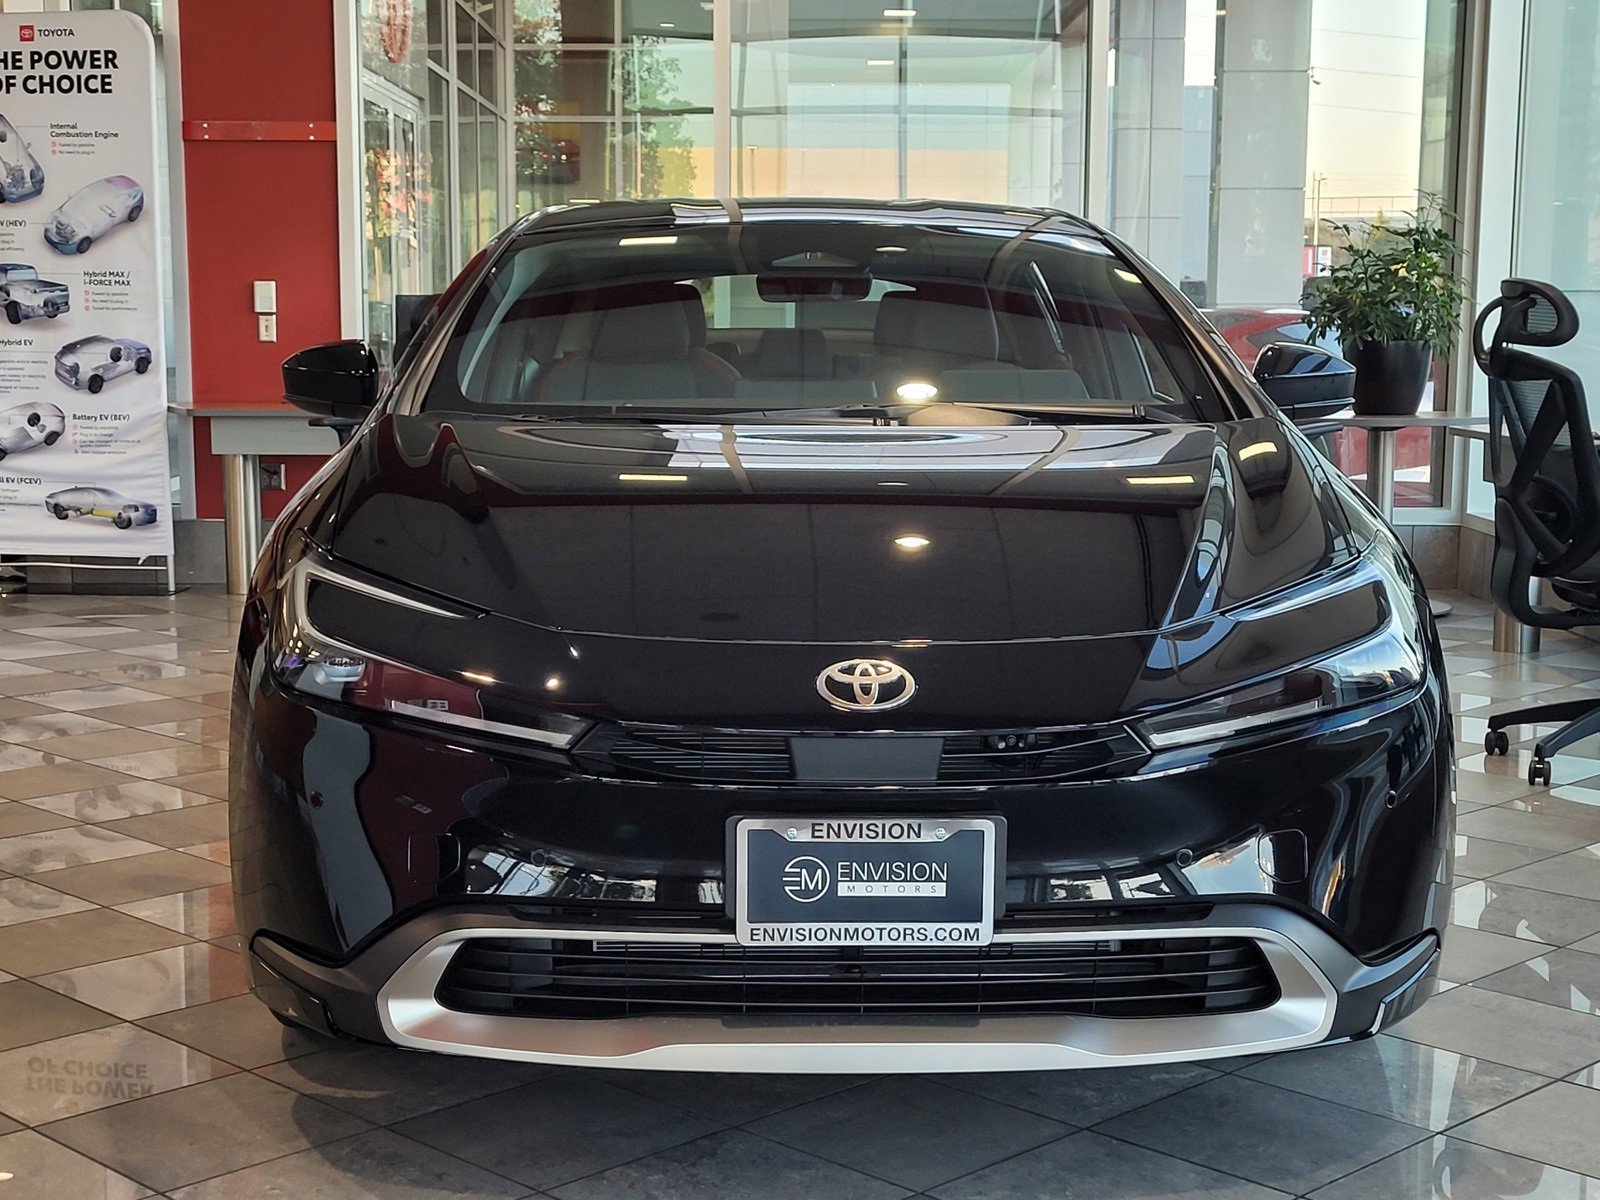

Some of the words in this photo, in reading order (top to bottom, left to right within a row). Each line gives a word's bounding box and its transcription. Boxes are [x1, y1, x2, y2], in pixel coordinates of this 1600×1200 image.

[37, 29, 75, 37] TOYOTA
[30, 50, 119, 70] POWER
[0, 75, 16, 94] F
[22, 74, 113, 94] CHOICE
[94, 131, 119, 139] Engine
[17, 477, 41, 485] (FCEV)
[811, 823, 922, 839] ENVISION
[837, 862, 948, 881] ENVISION
[846, 885, 937, 893] MOTORS
[750, 928, 980, 942] ENVISIONMOTORS.COM
